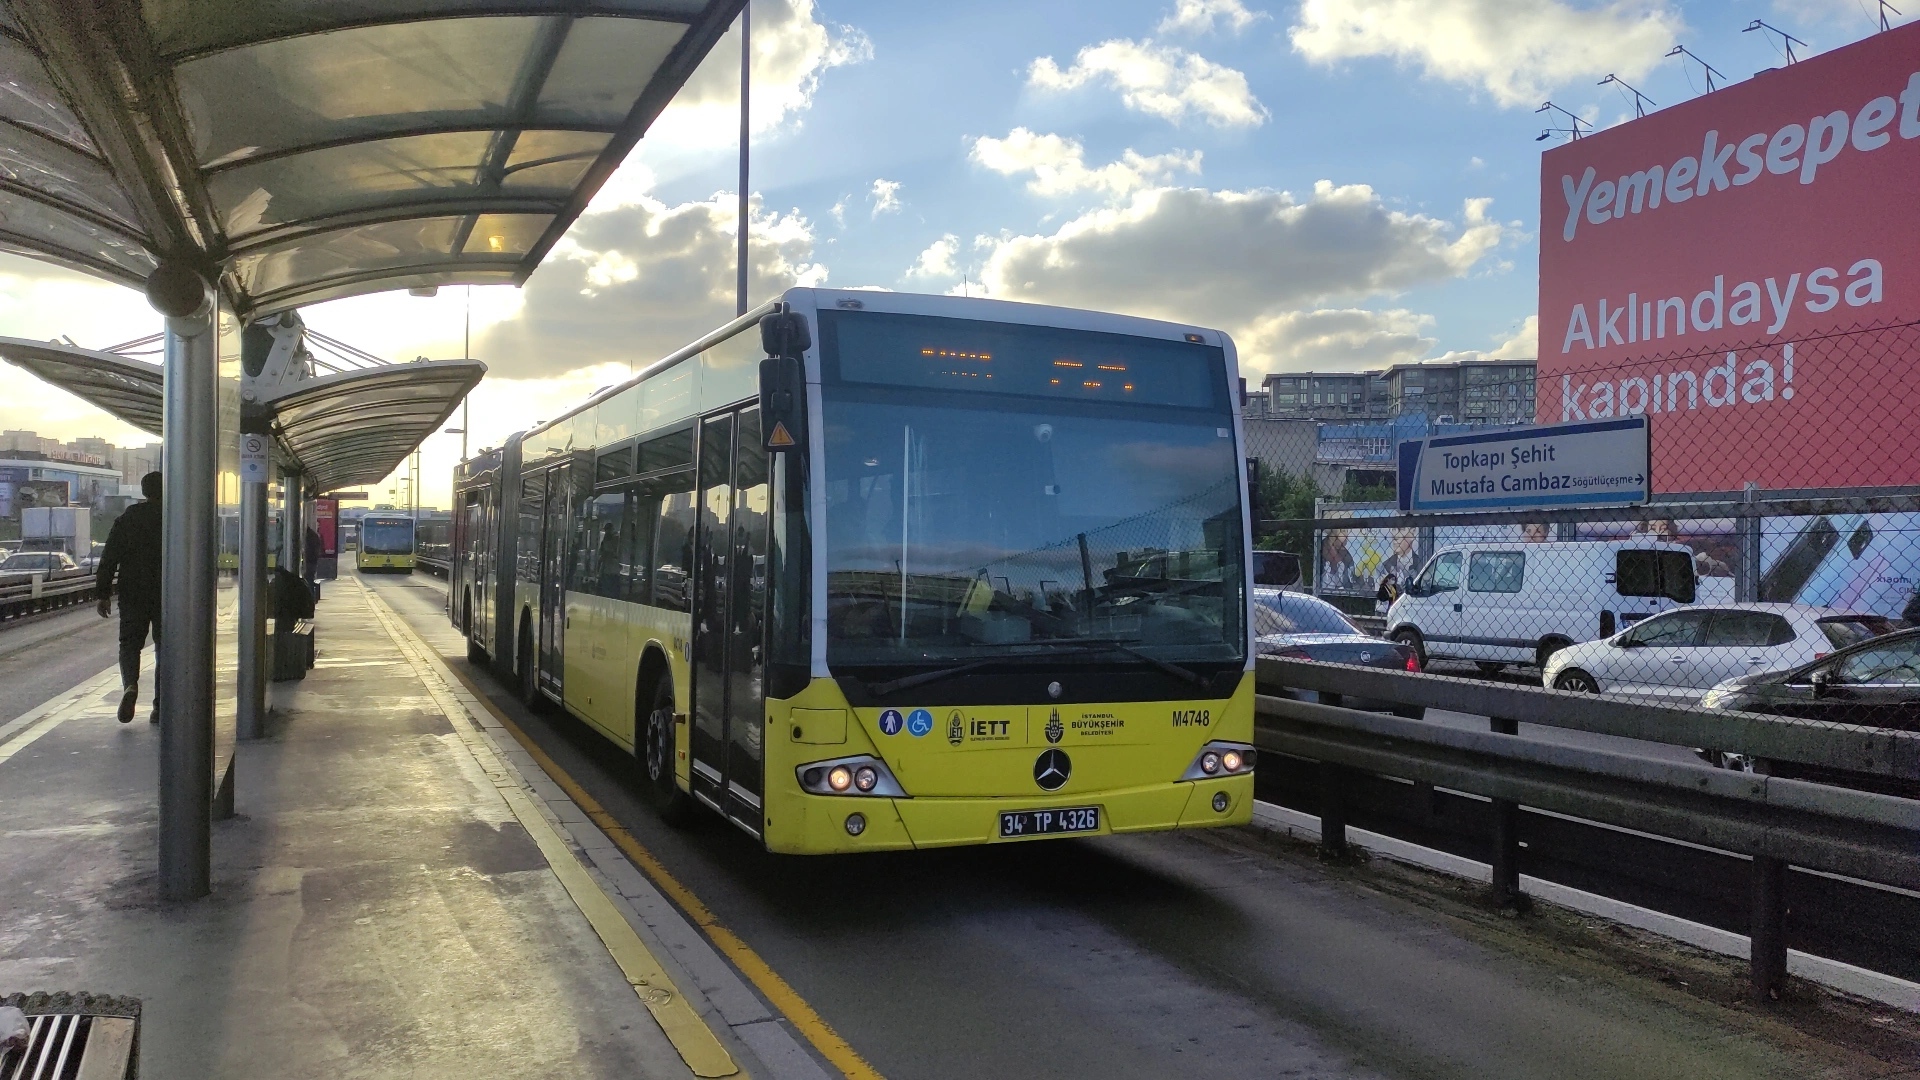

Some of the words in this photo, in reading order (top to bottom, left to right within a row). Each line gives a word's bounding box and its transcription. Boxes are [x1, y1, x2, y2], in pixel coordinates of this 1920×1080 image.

[1562, 71, 1920, 242] Yemeksepet
[1562, 258, 1884, 354] Aklındaysa
[1562, 343, 1796, 422] kapında!
[1443, 450, 1504, 472] Topkapı
[1511, 443, 1555, 469] Şehit
[1431, 475, 1495, 496] Mustafa
[1501, 472, 1570, 492] Cambaz
[1572, 475, 1633, 488] Söğütlüçeşme
[970, 717, 1010, 736] İETT
[1071, 719, 1125, 730] BÜYÜKŞEHİR
[1172, 710, 1210, 727] M4748
[1004, 814, 1023, 834] 34
[1033, 812, 1052, 832] TP
[1058, 809, 1095, 830] 4326
